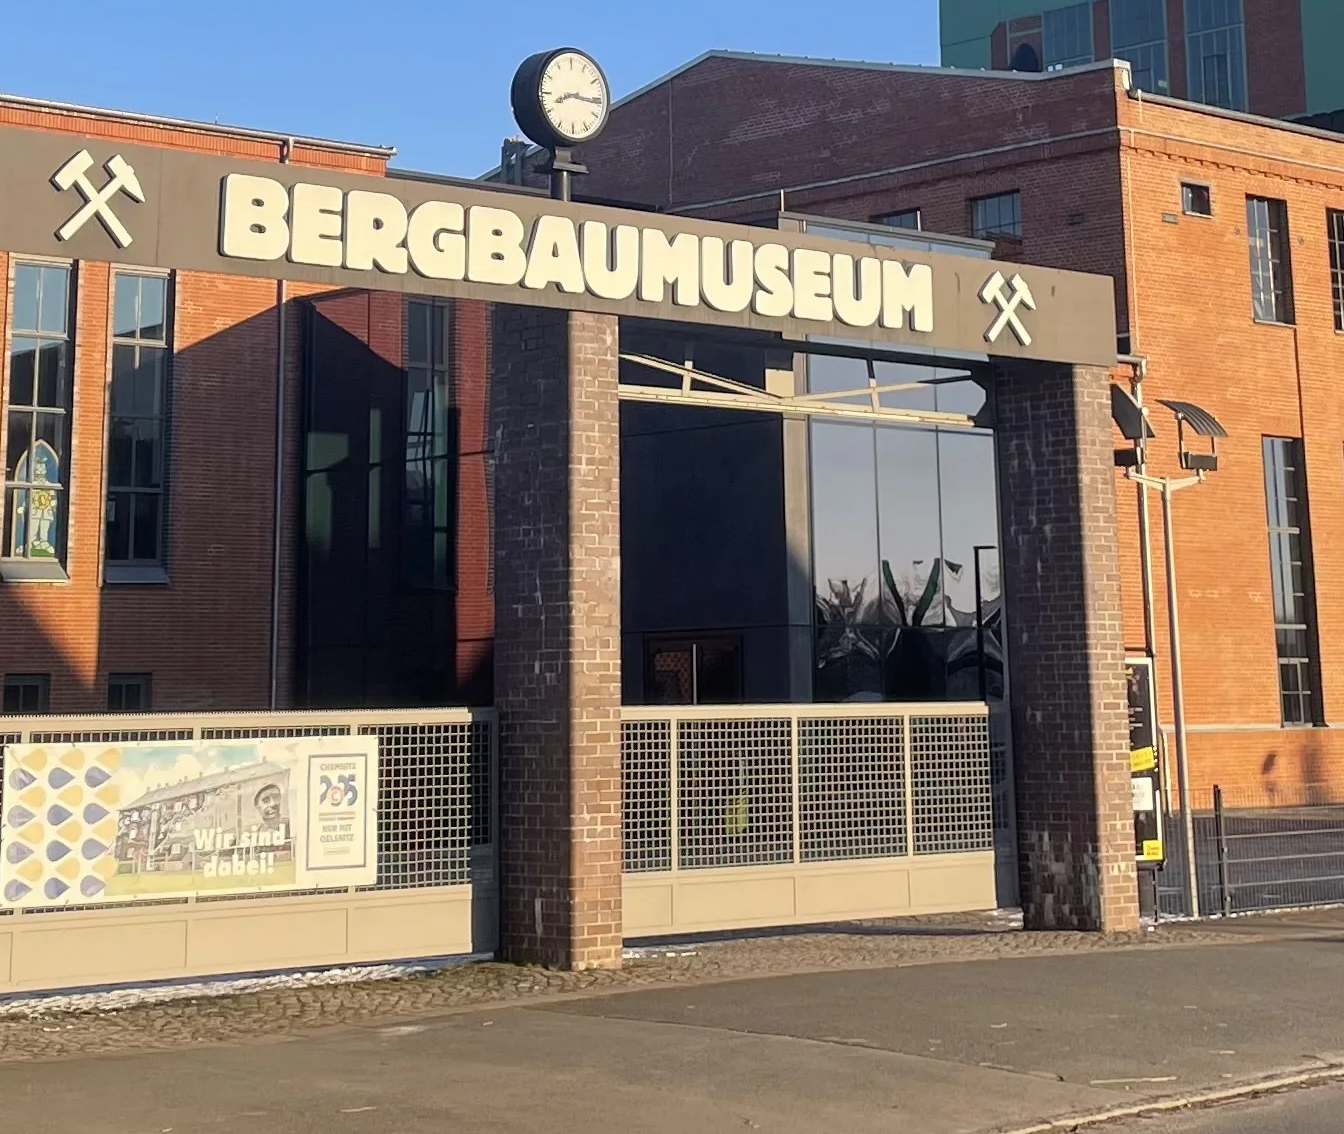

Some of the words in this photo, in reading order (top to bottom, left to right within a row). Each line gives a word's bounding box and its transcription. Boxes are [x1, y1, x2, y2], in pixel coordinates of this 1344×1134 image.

[219, 173, 934, 333] BERGBAUMUSEUM
[193, 826, 235, 851] Wir
[240, 823, 286, 848] sind
[203, 851, 276, 878] dabei!
